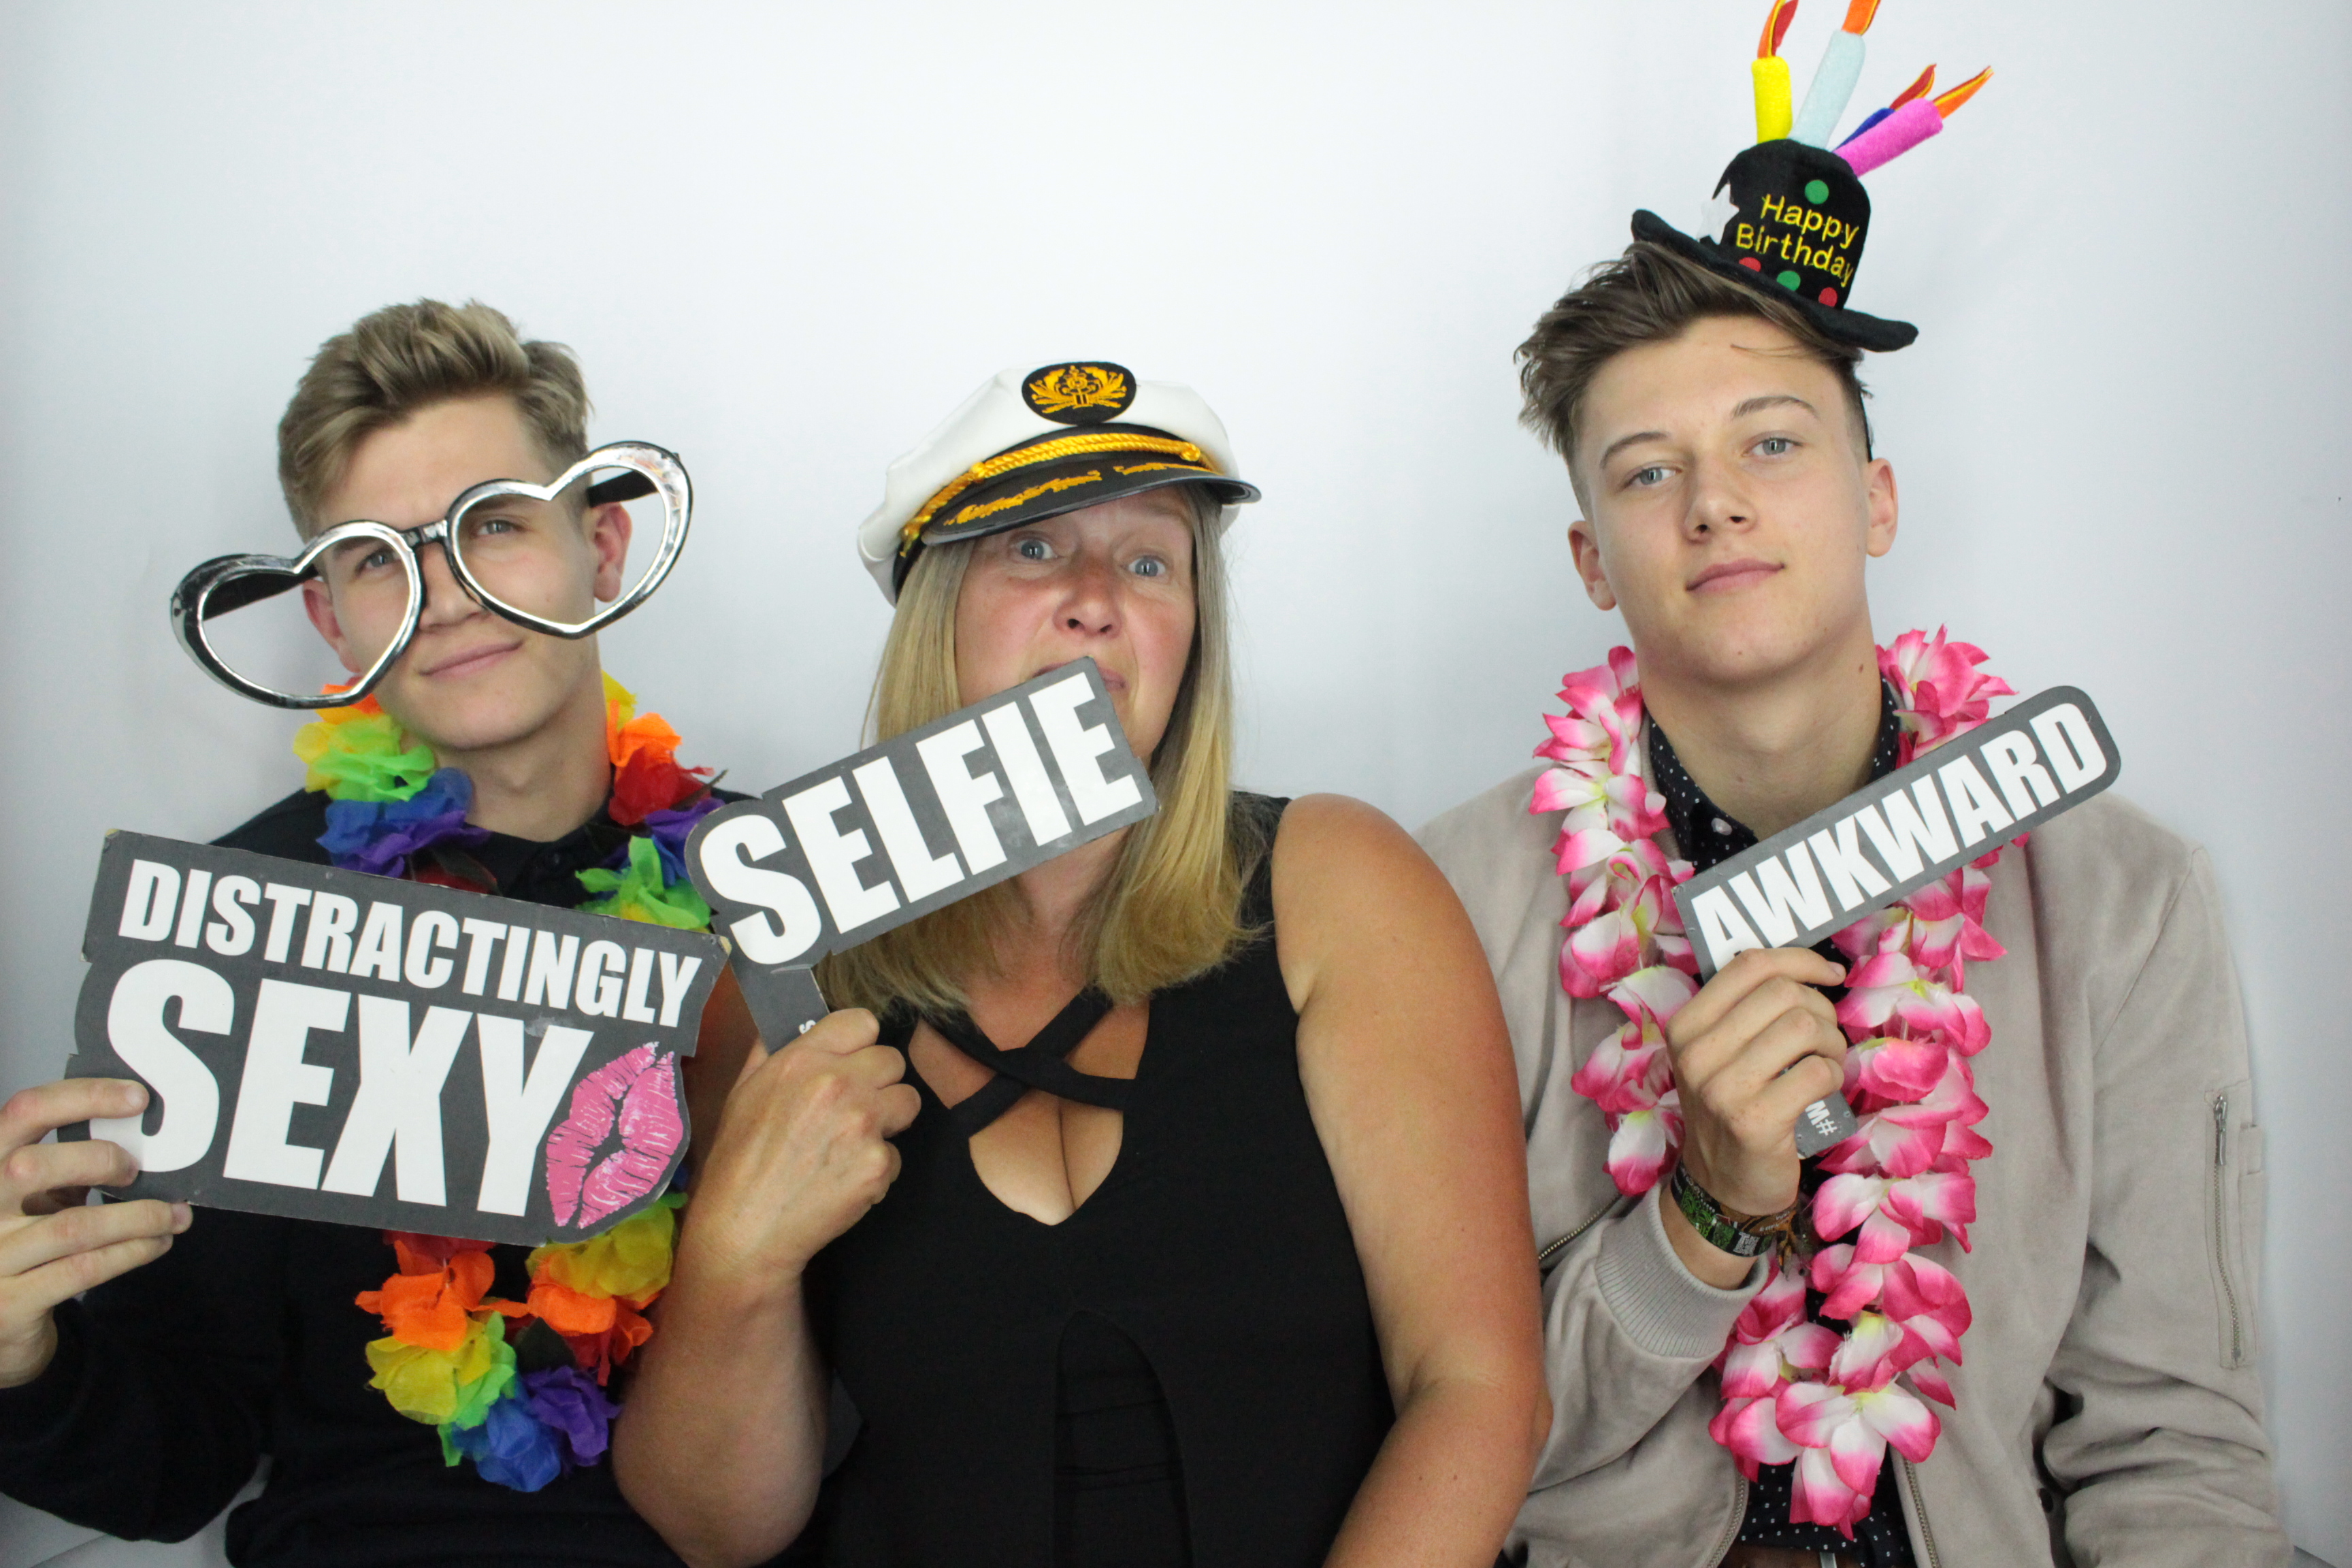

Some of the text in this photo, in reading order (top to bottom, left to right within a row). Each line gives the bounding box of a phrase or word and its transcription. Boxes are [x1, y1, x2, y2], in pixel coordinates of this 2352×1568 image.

[1735, 223, 1856, 287] Birthday
[1760, 194, 1859, 249] Happy
[700, 671, 1143, 965] SELFIE
[1690, 702, 2107, 972] AWKWARD
[118, 859, 702, 1028] DISTRACTINGLY
[89, 959, 594, 1217] SEXY
